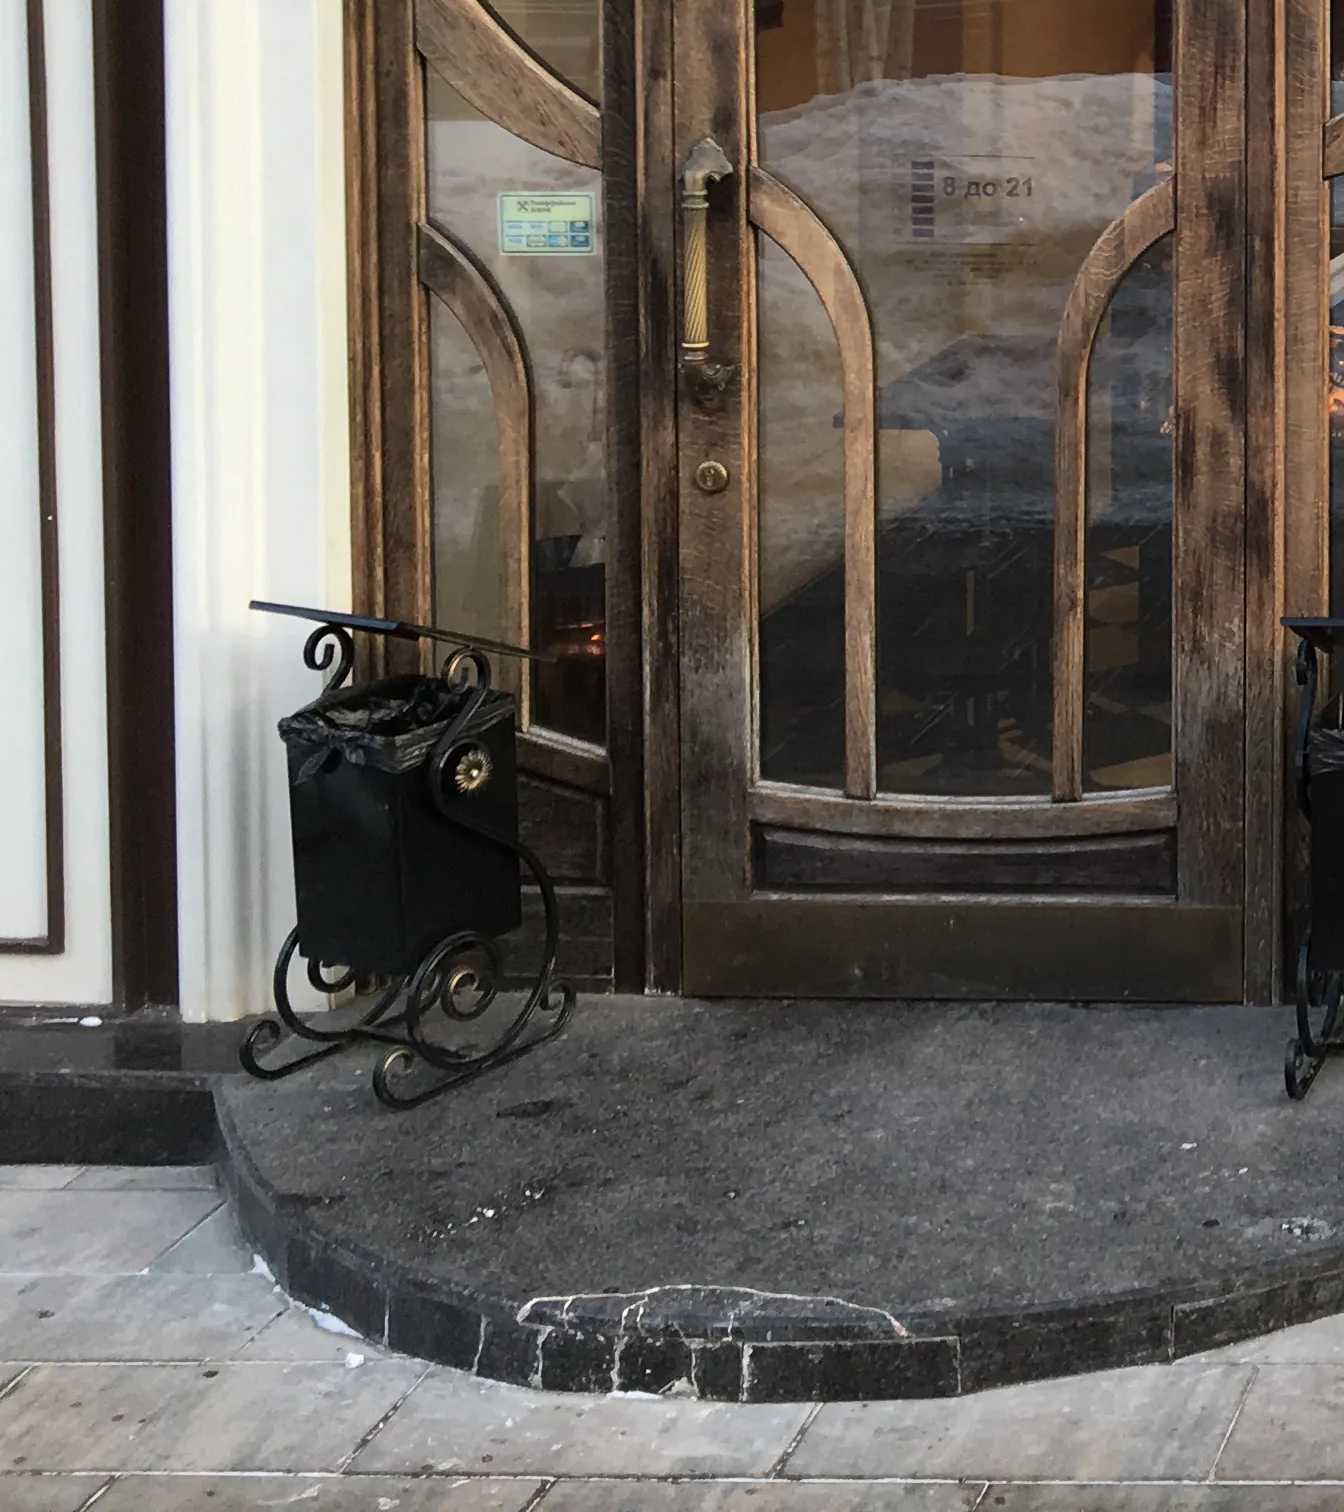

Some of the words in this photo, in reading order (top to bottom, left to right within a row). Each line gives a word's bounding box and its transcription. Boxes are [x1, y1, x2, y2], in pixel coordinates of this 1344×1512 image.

[942, 176, 956, 197] 8
[964, 180, 999, 200] до
[1005, 176, 1033, 198] 21
